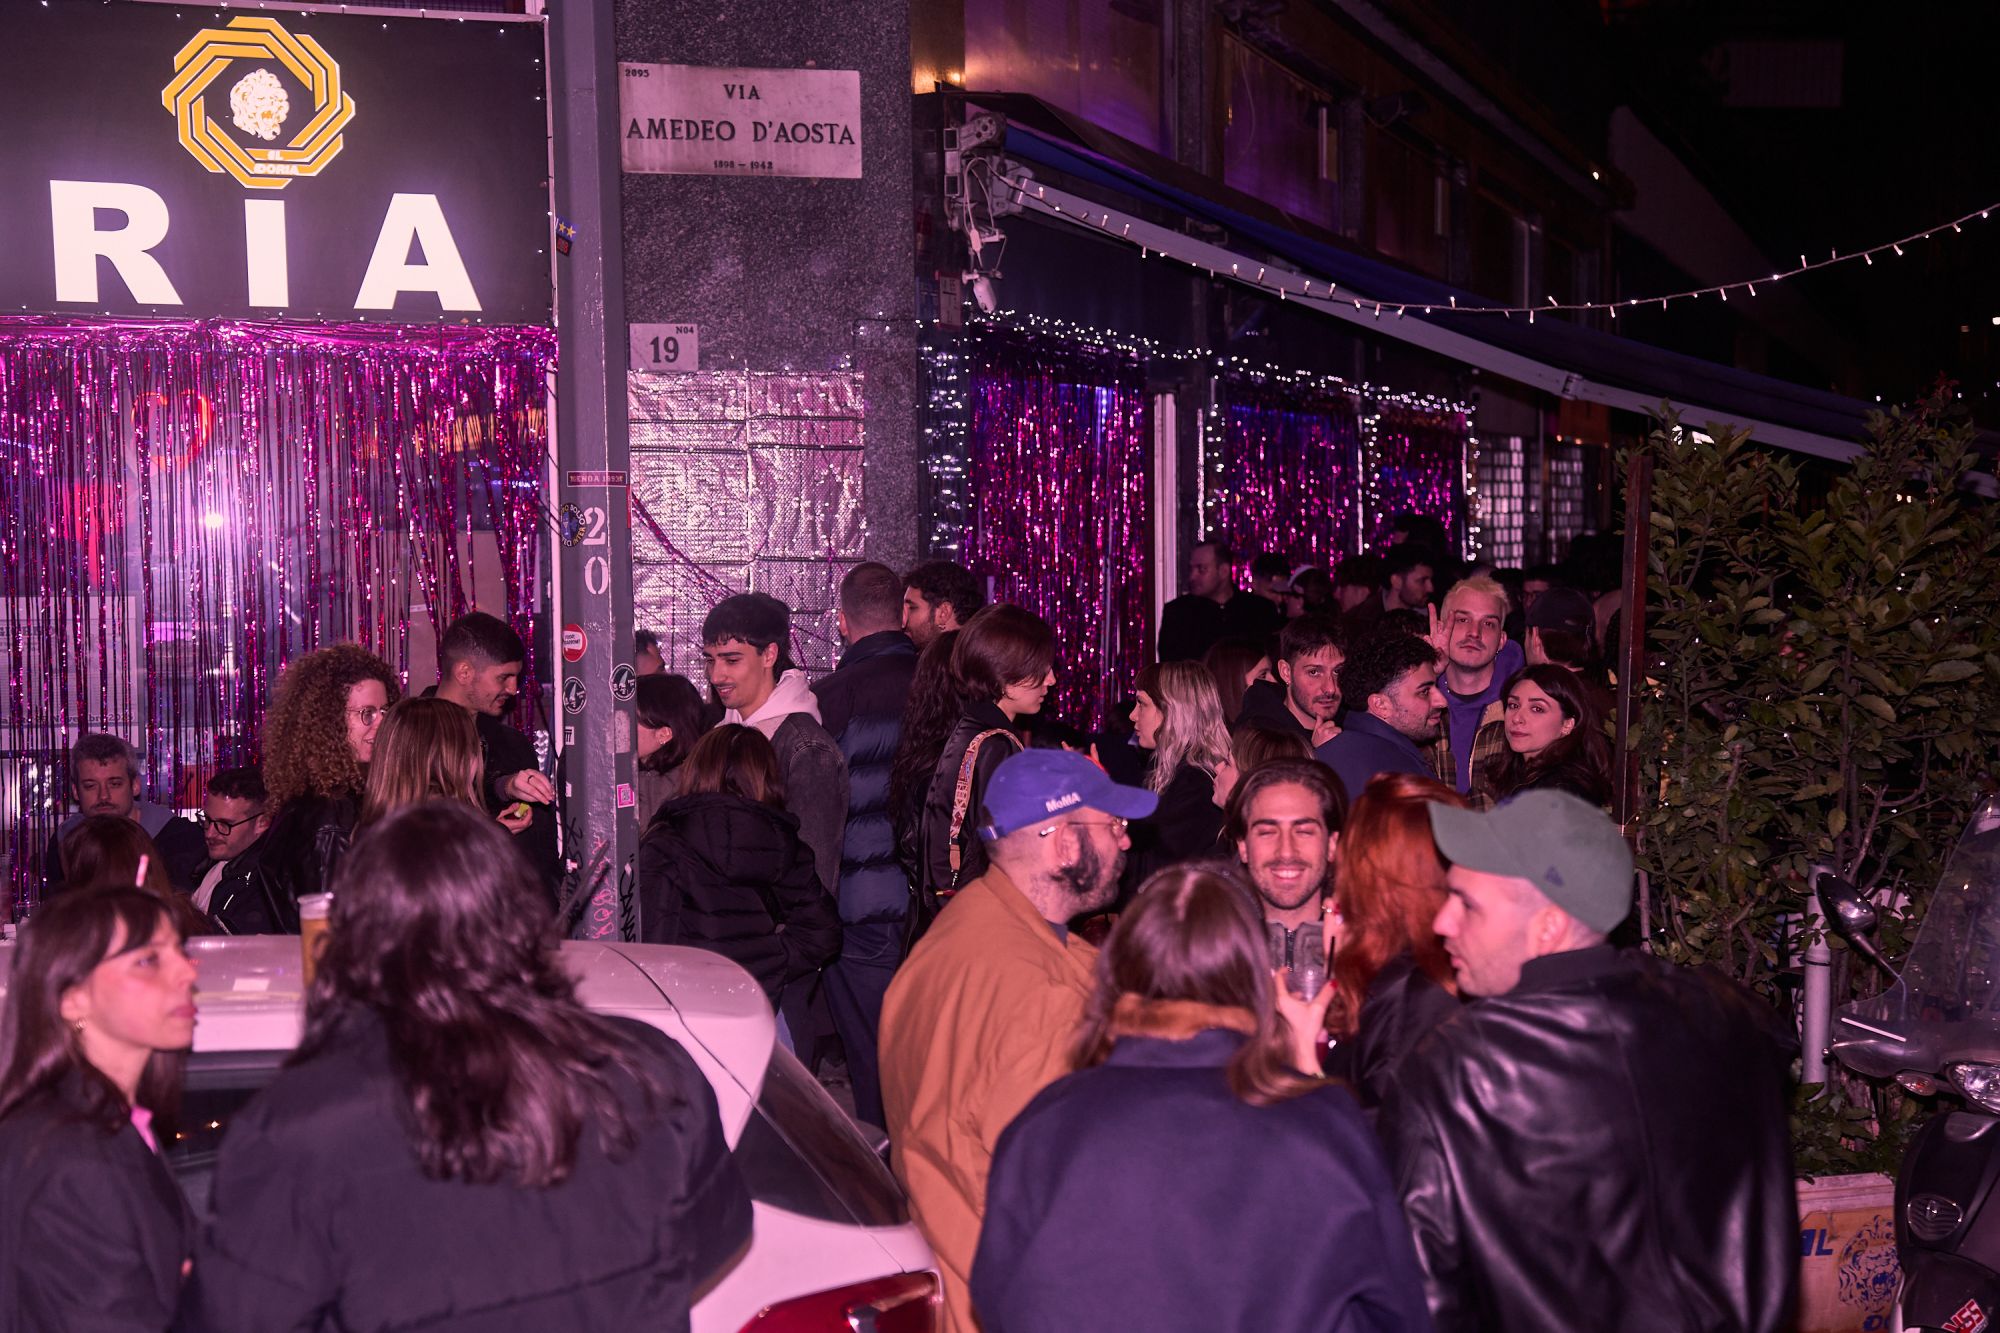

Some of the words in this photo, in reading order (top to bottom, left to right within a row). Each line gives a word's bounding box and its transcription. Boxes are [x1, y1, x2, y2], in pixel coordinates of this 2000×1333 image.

[724, 84, 761, 100] VIA
[626, 118, 736, 142] AMEDEO
[752, 120, 856, 145] D'AOSTA
[253, 163, 299, 175] DORIA
[649, 336, 679, 363] 19
[1045, 792, 1082, 813] MoMA
